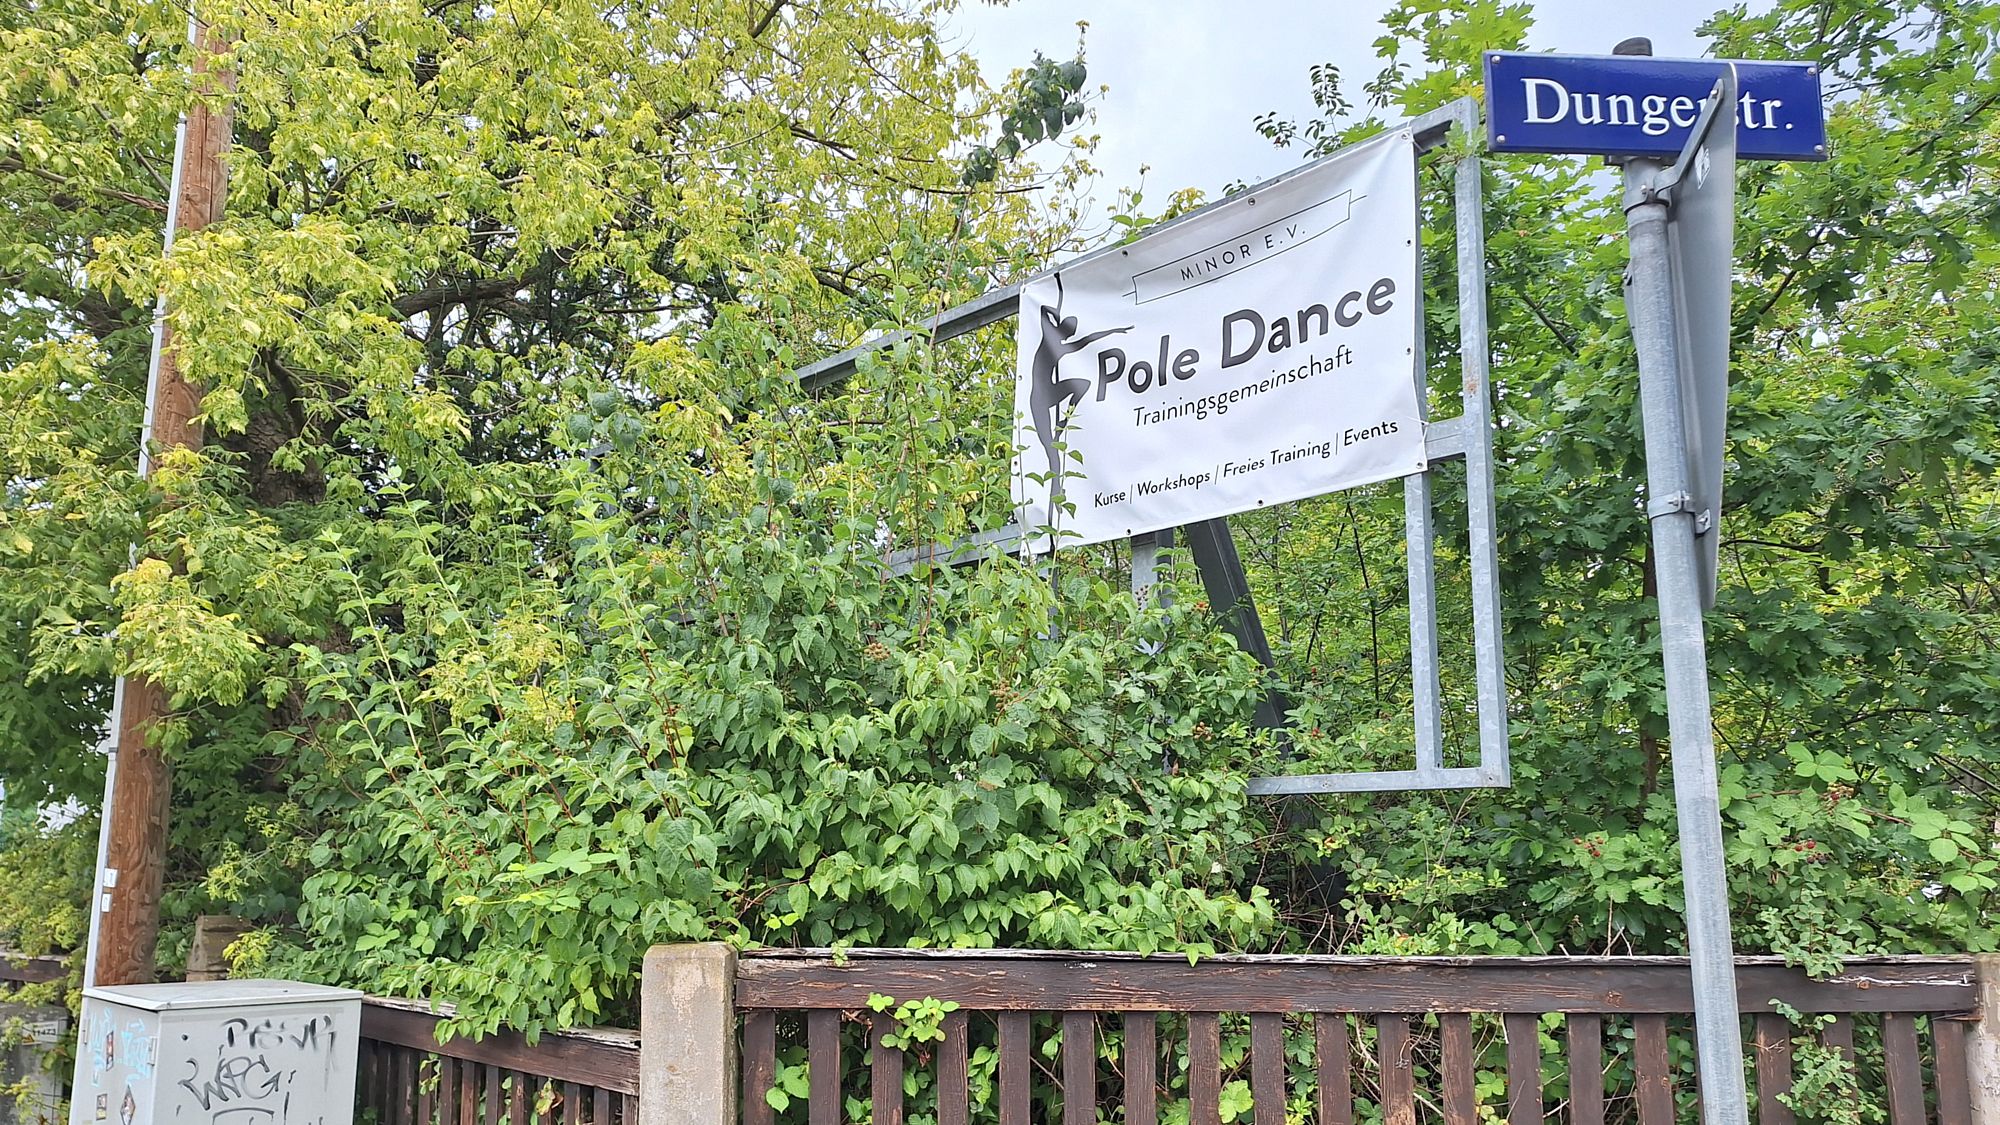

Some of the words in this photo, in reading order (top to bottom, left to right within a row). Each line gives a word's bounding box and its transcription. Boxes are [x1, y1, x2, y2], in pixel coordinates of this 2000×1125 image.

[1520, 78, 1793, 136] Dungetr.
[1180, 244, 1252, 281] MINOR
[1264, 224, 1306, 250] E.V.
[1096, 335, 1200, 402] Pole
[1221, 277, 1396, 369] Dance
[1133, 344, 1353, 427] Trainingsgemeinschaft
[1094, 491, 1126, 508] Kurse
[1137, 472, 1211, 497] Workshops
[1223, 457, 1265, 478] Freies
[1270, 441, 1331, 465] Training
[1344, 420, 1398, 447] Events
